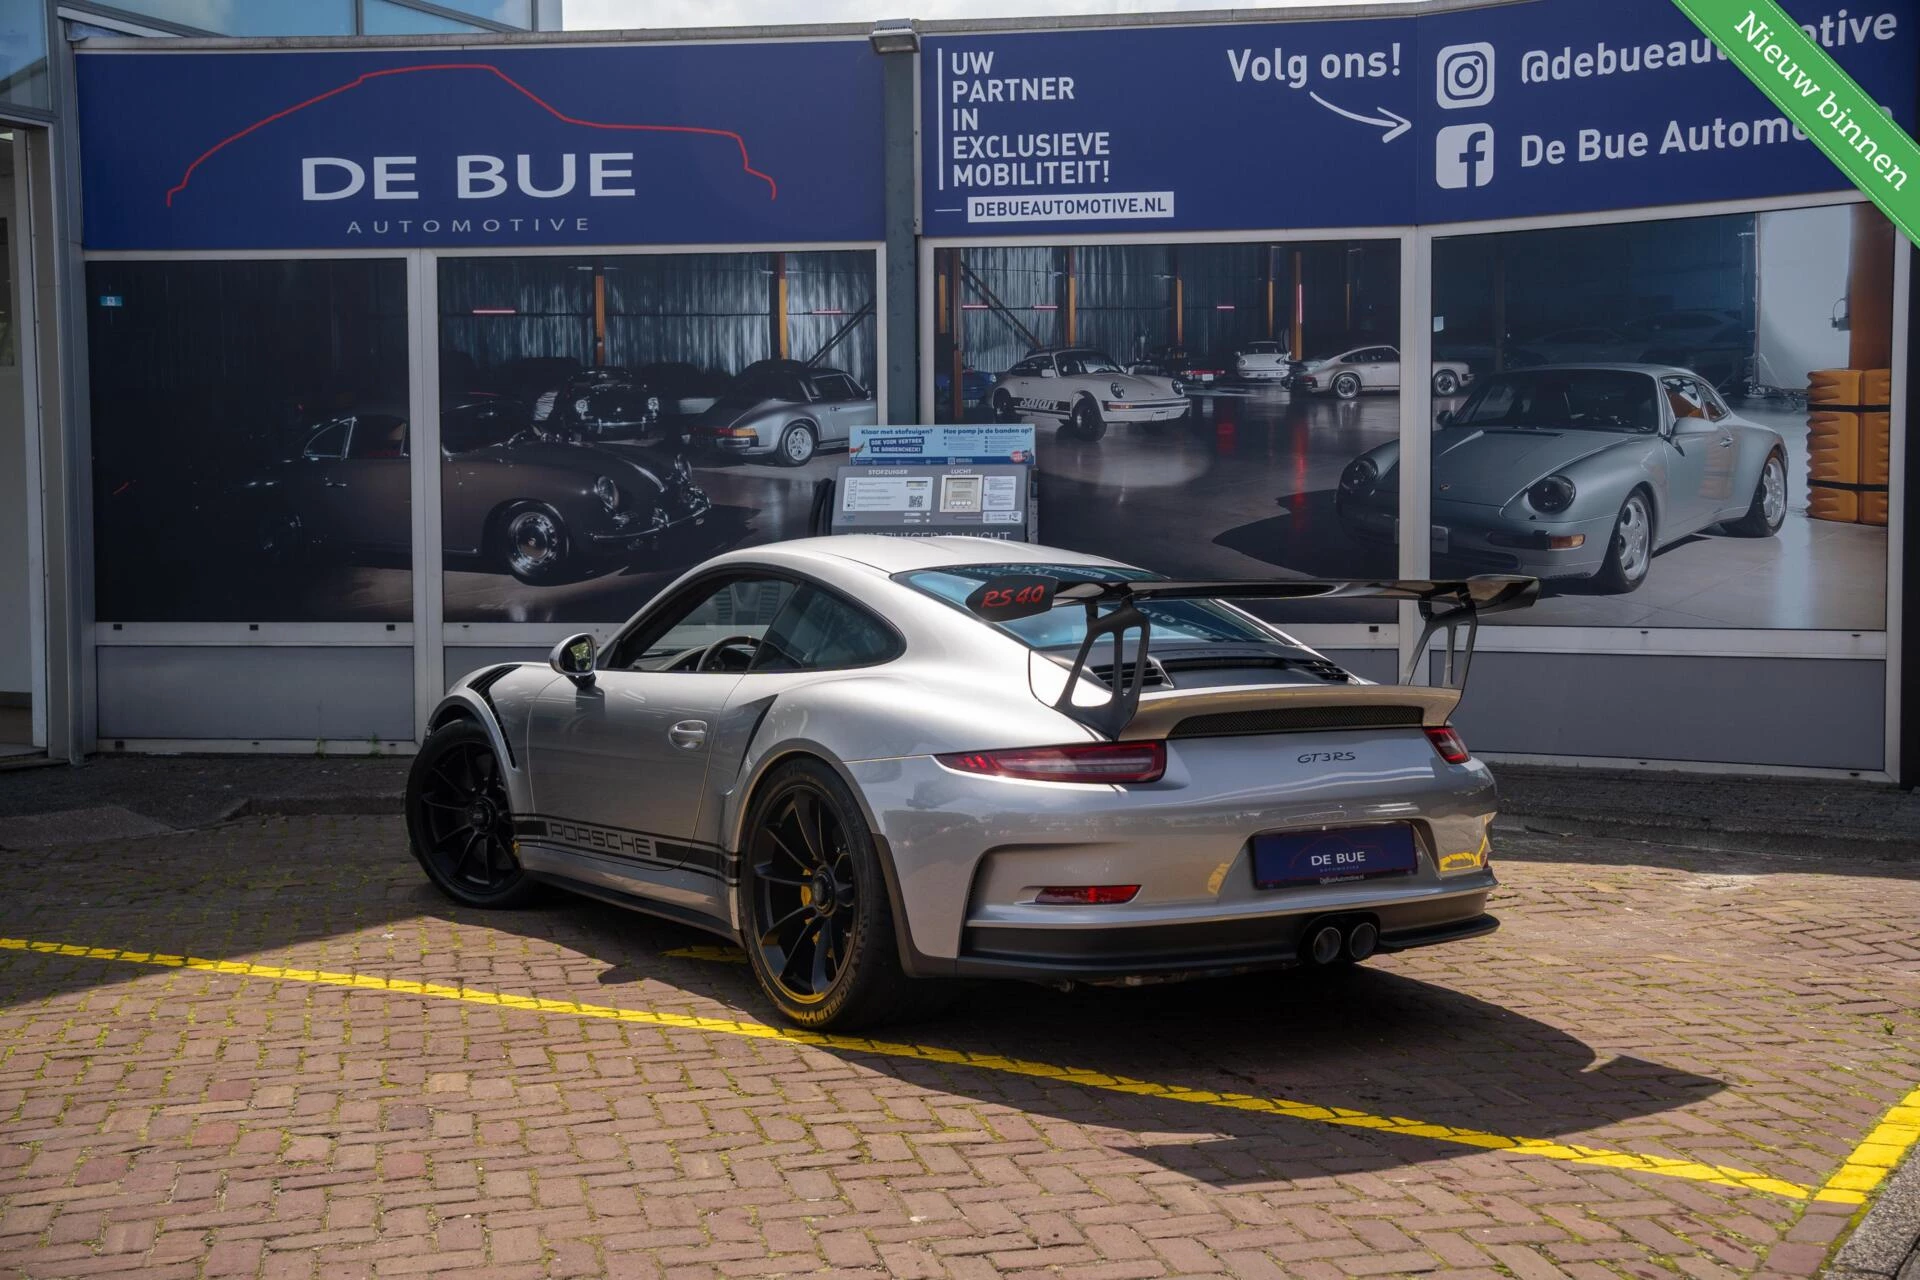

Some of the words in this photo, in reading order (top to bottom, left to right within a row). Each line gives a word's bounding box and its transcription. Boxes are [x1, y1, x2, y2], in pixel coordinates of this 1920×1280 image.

[952, 51, 994, 75] UW
[1227, 47, 1307, 89] Volg
[1320, 42, 1401, 79] ons!
[952, 77, 1075, 103] PARTNER
[952, 107, 978, 131] IN
[953, 131, 1110, 160] EXCLUSIEVE
[1521, 134, 1566, 168] De
[1578, 128, 1649, 163] Bue
[302, 156, 419, 201] DE
[457, 152, 636, 198] BUE
[953, 160, 1109, 187] MOBILITEIT!
[974, 198, 1167, 217] DEBUEAUTOMOTIVE.NL
[347, 218, 590, 234] AUTOMOTIVE
[1020, 396, 1059, 410] Safari
[977, 427, 984, 435] je
[1021, 427, 1033, 435] op?
[981, 587, 1015, 608] RS
[551, 823, 652, 856] PORSCHE
[1311, 854, 1332, 866] DE
[1336, 851, 1366, 864] BUE
